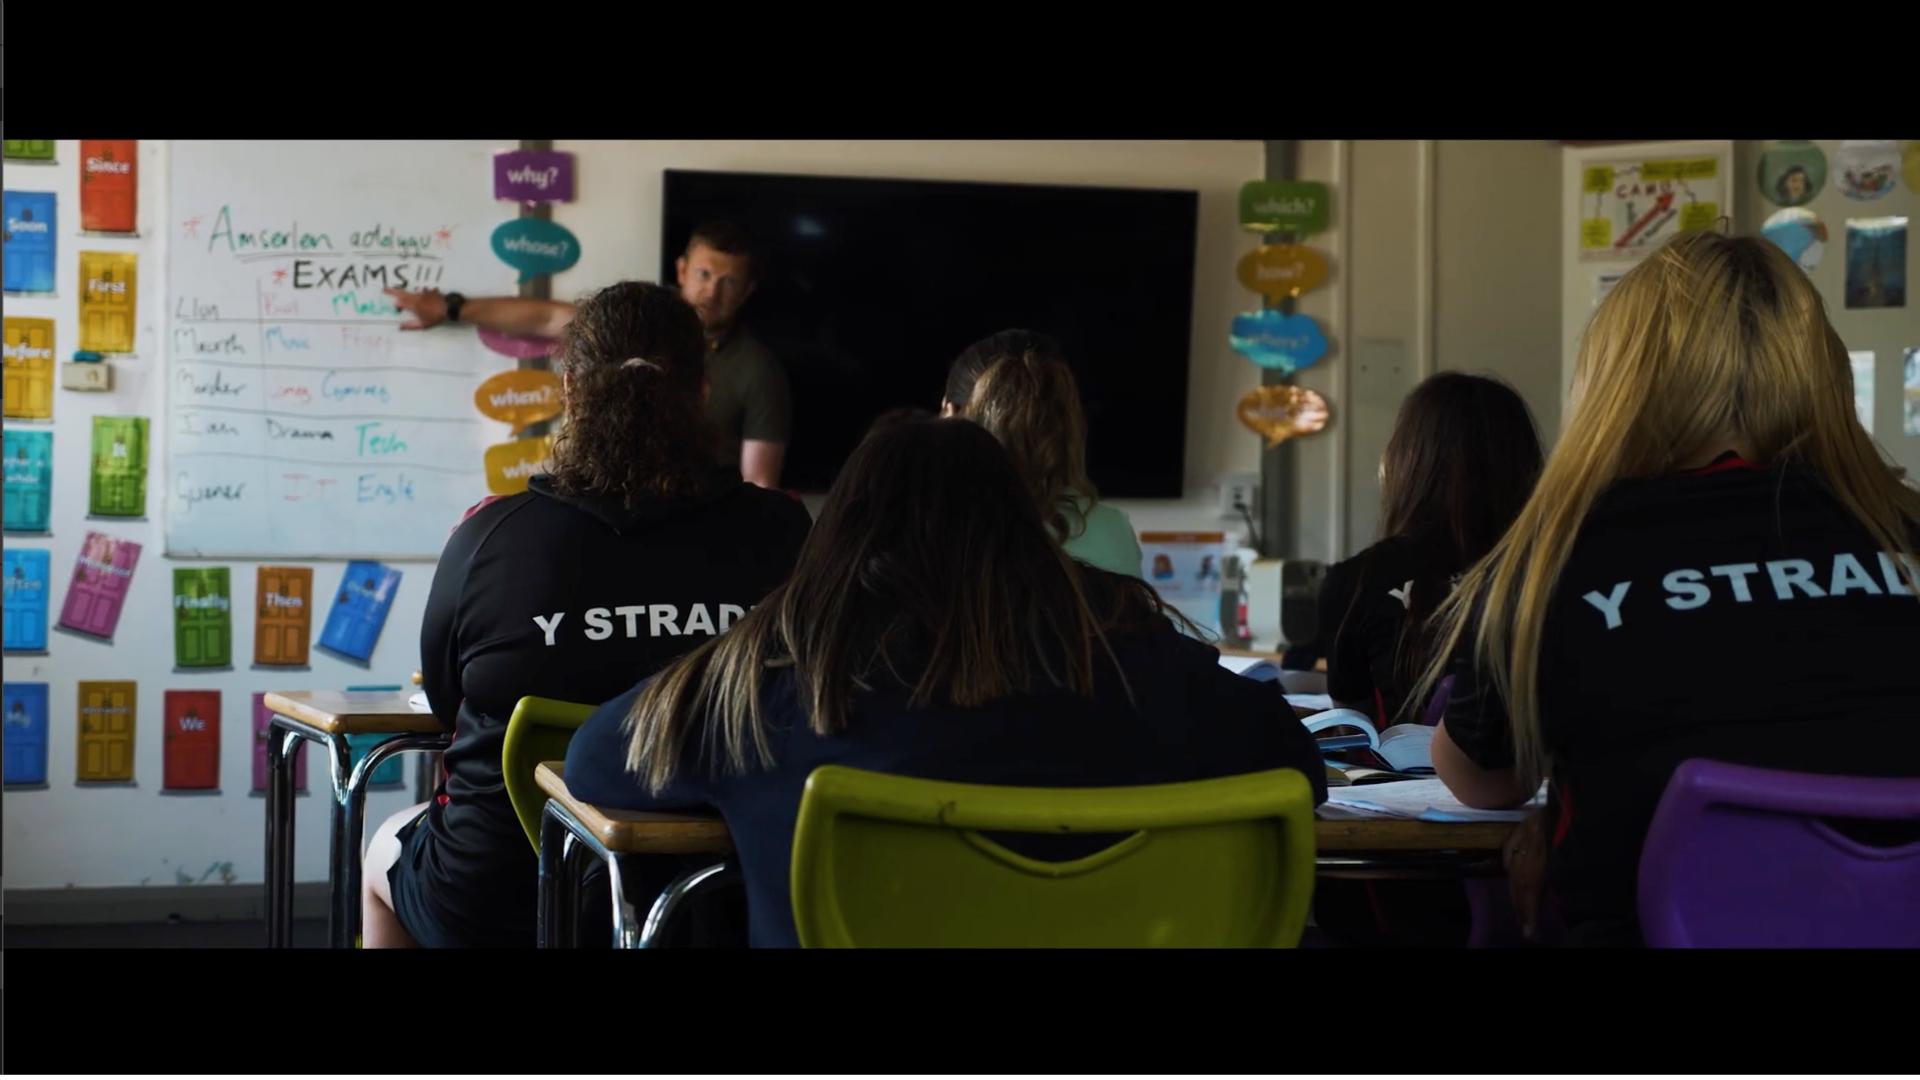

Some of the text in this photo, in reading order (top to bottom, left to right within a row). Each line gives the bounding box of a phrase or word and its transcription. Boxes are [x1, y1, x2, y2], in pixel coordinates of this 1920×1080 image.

[87, 157, 130, 174] Since
[507, 166, 559, 189] why?
[8, 218, 48, 233] Soon
[503, 235, 569, 258] whose?
[88, 278, 126, 294] First
[489, 384, 552, 408] when?
[266, 417, 335, 441] Drama
[174, 594, 230, 611] Finally
[266, 592, 302, 609] Then
[1387, 579, 1416, 609] Y
[1582, 581, 1633, 630] Y
[533, 612, 565, 646] Y
[179, 716, 207, 732] We
